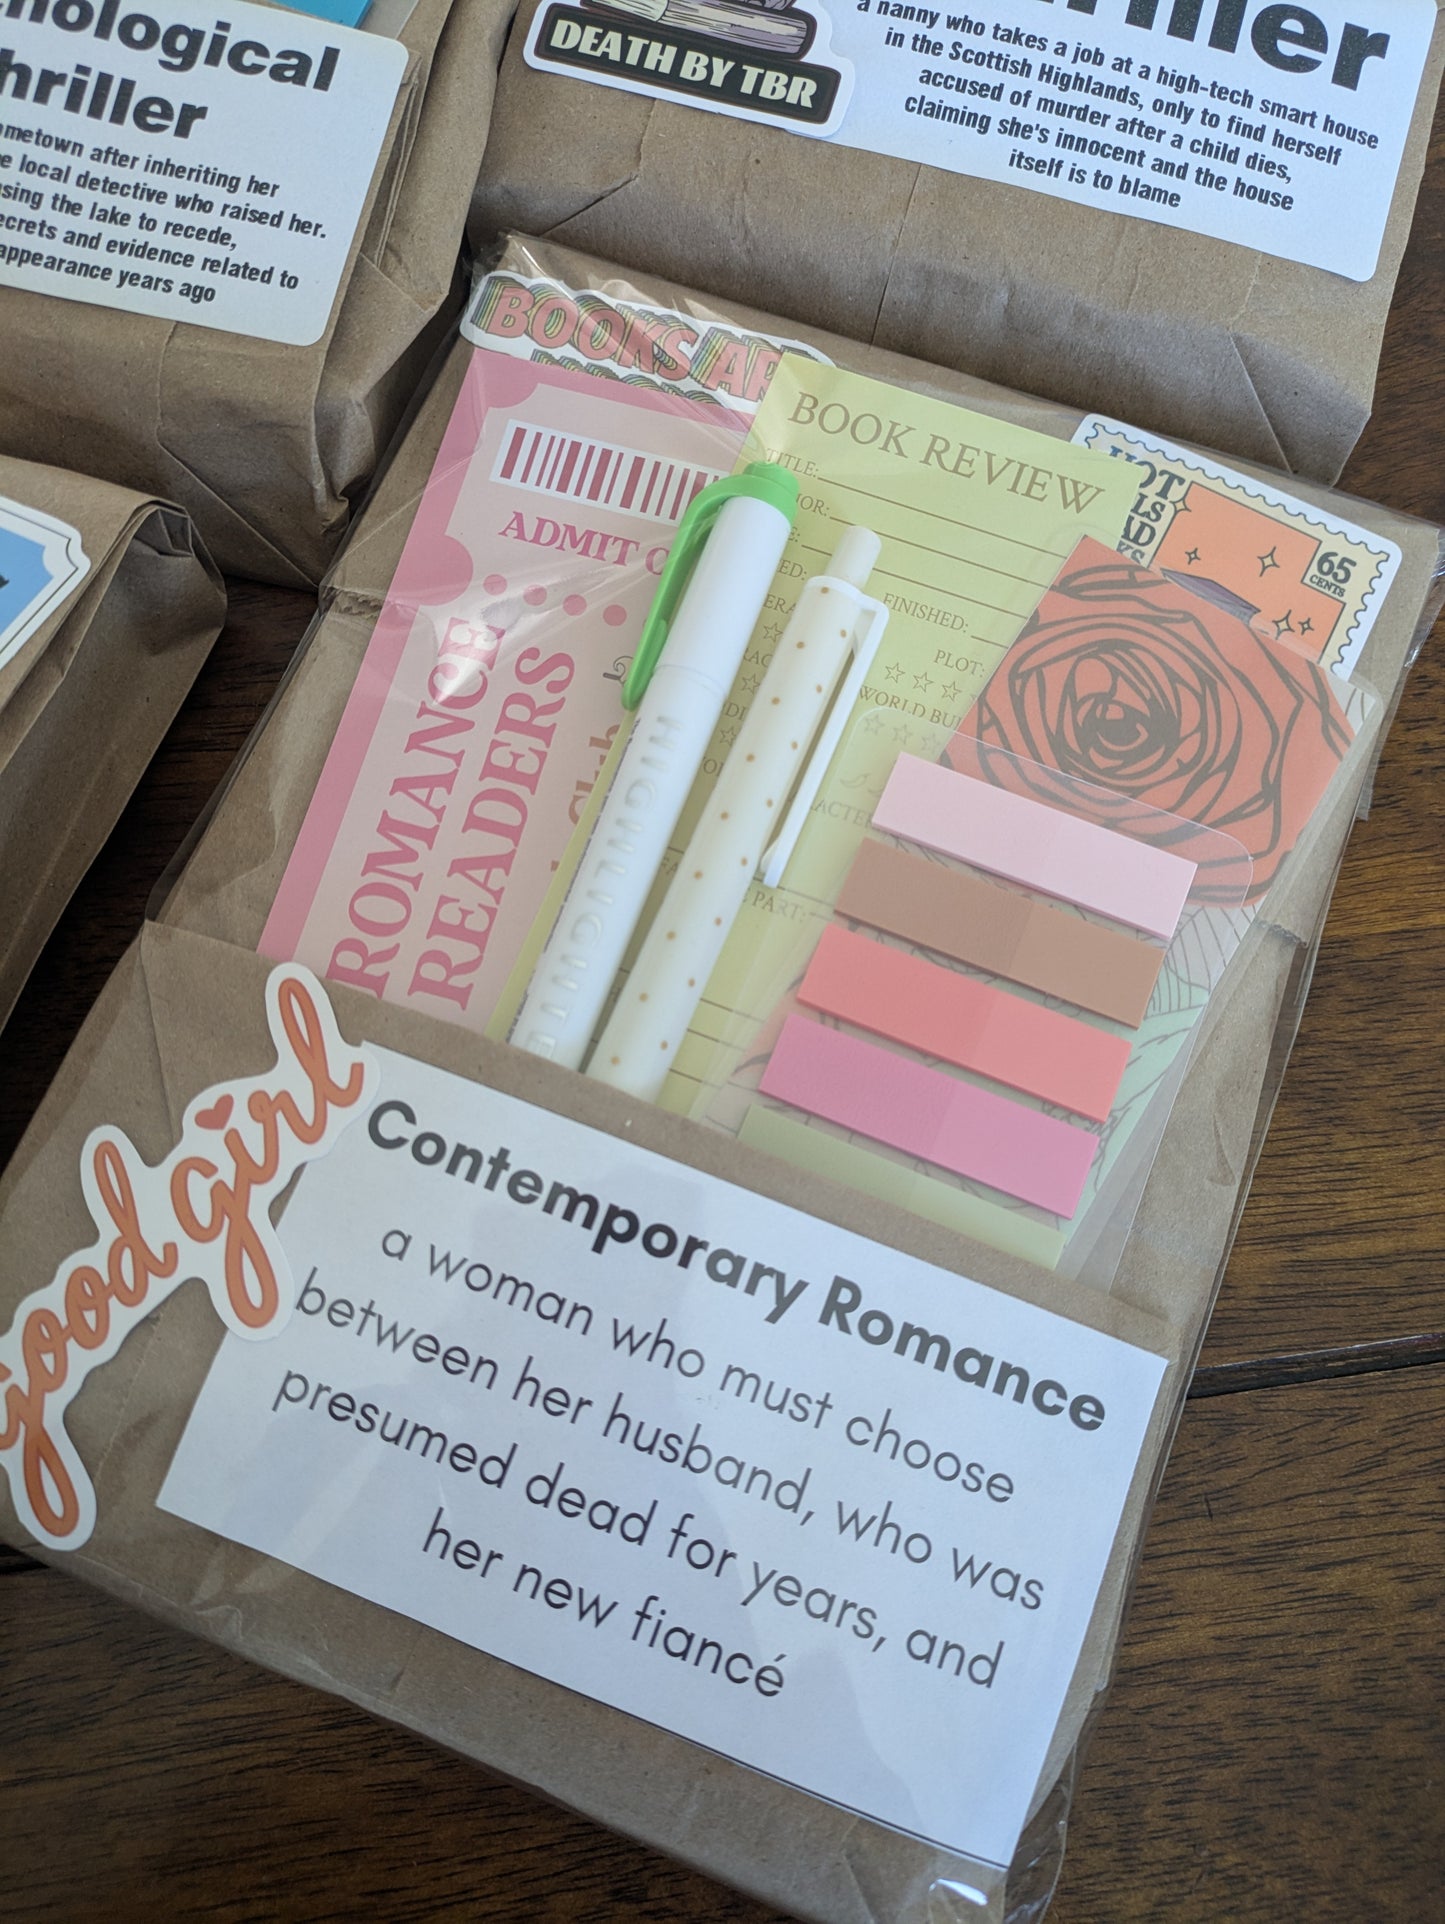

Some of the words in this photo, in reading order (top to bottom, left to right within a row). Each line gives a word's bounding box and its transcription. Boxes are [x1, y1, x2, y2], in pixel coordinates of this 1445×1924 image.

[550, 19, 678, 75] DEATH
[679, 50, 728, 88] BY
[741, 65, 818, 109] TBR
[857, 0, 870, 12] a
[876, 0, 940, 29] nanny
[946, 14, 986, 37] who
[992, 22, 1049, 52] takes
[1053, 41, 1068, 57] a
[1071, 42, 1105, 67] job
[1111, 55, 1133, 75] at
[1138, 63, 1151, 81] a
[1157, 65, 1254, 110] high-tech
[1258, 93, 1318, 127] smart
[1322, 113, 1380, 150] house
[884, 27, 905, 48] in
[911, 33, 944, 57] the
[948, 41, 1032, 79] Scottish
[1037, 62, 1144, 111] Highlands,
[1151, 95, 1193, 126] only
[1200, 106, 1221, 130] to
[1225, 113, 1264, 143] find
[1271, 127, 1342, 167] herself
[0, 122, 84, 158] metown
[90, 145, 140, 171] after
[144, 155, 241, 195] inheriting
[247, 174, 280, 199] her
[904, 94, 991, 136] claiming
[997, 114, 1050, 145] she's
[1055, 126, 1146, 168] innocent
[1151, 150, 1188, 182] and
[1195, 165, 1227, 190] the
[1232, 175, 1294, 211] house
[919, 68, 1005, 102] accused
[1009, 89, 1032, 108] of
[1036, 96, 1111, 128] murder
[1115, 114, 1166, 150] after
[1170, 132, 1185, 151] a
[1189, 135, 1240, 168] child
[1244, 146, 1293, 184] dies,
[1008, 149, 1063, 180] itself
[1067, 162, 1087, 185] is
[1093, 167, 1114, 190] to
[1119, 175, 1181, 209] blame
[0, 181, 44, 211] sing
[51, 193, 83, 217] the
[89, 202, 131, 228] lake
[138, 211, 157, 233] to
[163, 220, 238, 251] recede,
[19, 154, 71, 185] local
[76, 170, 168, 205] detective
[175, 193, 214, 215] who
[220, 201, 284, 229] raised
[288, 217, 327, 240] her.
[62, 229, 102, 251] and
[105, 238, 195, 269] evidence
[200, 253, 272, 284] related
[279, 269, 299, 290] to
[116, 269, 173, 296] years
[179, 281, 216, 304] ago
[480, 281, 699, 381] BOOKS
[787, 391, 916, 459] BOOK
[919, 433, 1106, 515] REVIEW
[498, 511, 640, 567] ADMIT
[1309, 574, 1347, 599] CENTS
[1316, 552, 1357, 584] 65
[882, 592, 970, 633] FINISHED:
[933, 648, 986, 678] PLOT:
[324, 616, 506, 1000] ROMANCE
[407, 646, 576, 1012] READERS
[170, 977, 365, 1329] girl
[368, 1100, 809, 1324] Contemporary
[818, 1275, 1106, 1432] Romance
[381, 1229, 412, 1262] a
[429, 1244, 594, 1336] woman
[612, 1317, 705, 1378] who
[720, 1364, 834, 1430] must
[845, 1408, 1015, 1503] choose
[295, 1267, 499, 1391] between
[512, 1355, 594, 1425] her
[602, 1392, 815, 1526] husband,
[837, 1500, 932, 1564] who
[951, 1547, 1045, 1611] was
[272, 1369, 518, 1488] presumed
[525, 1462, 659, 1547] dead
[666, 1513, 738, 1578] for
[741, 1560, 887, 1653] years,
[906, 1629, 1005, 1689] and
[421, 1507, 504, 1579] her
[512, 1563, 619, 1628] new
[629, 1595, 788, 1698] fiancé
